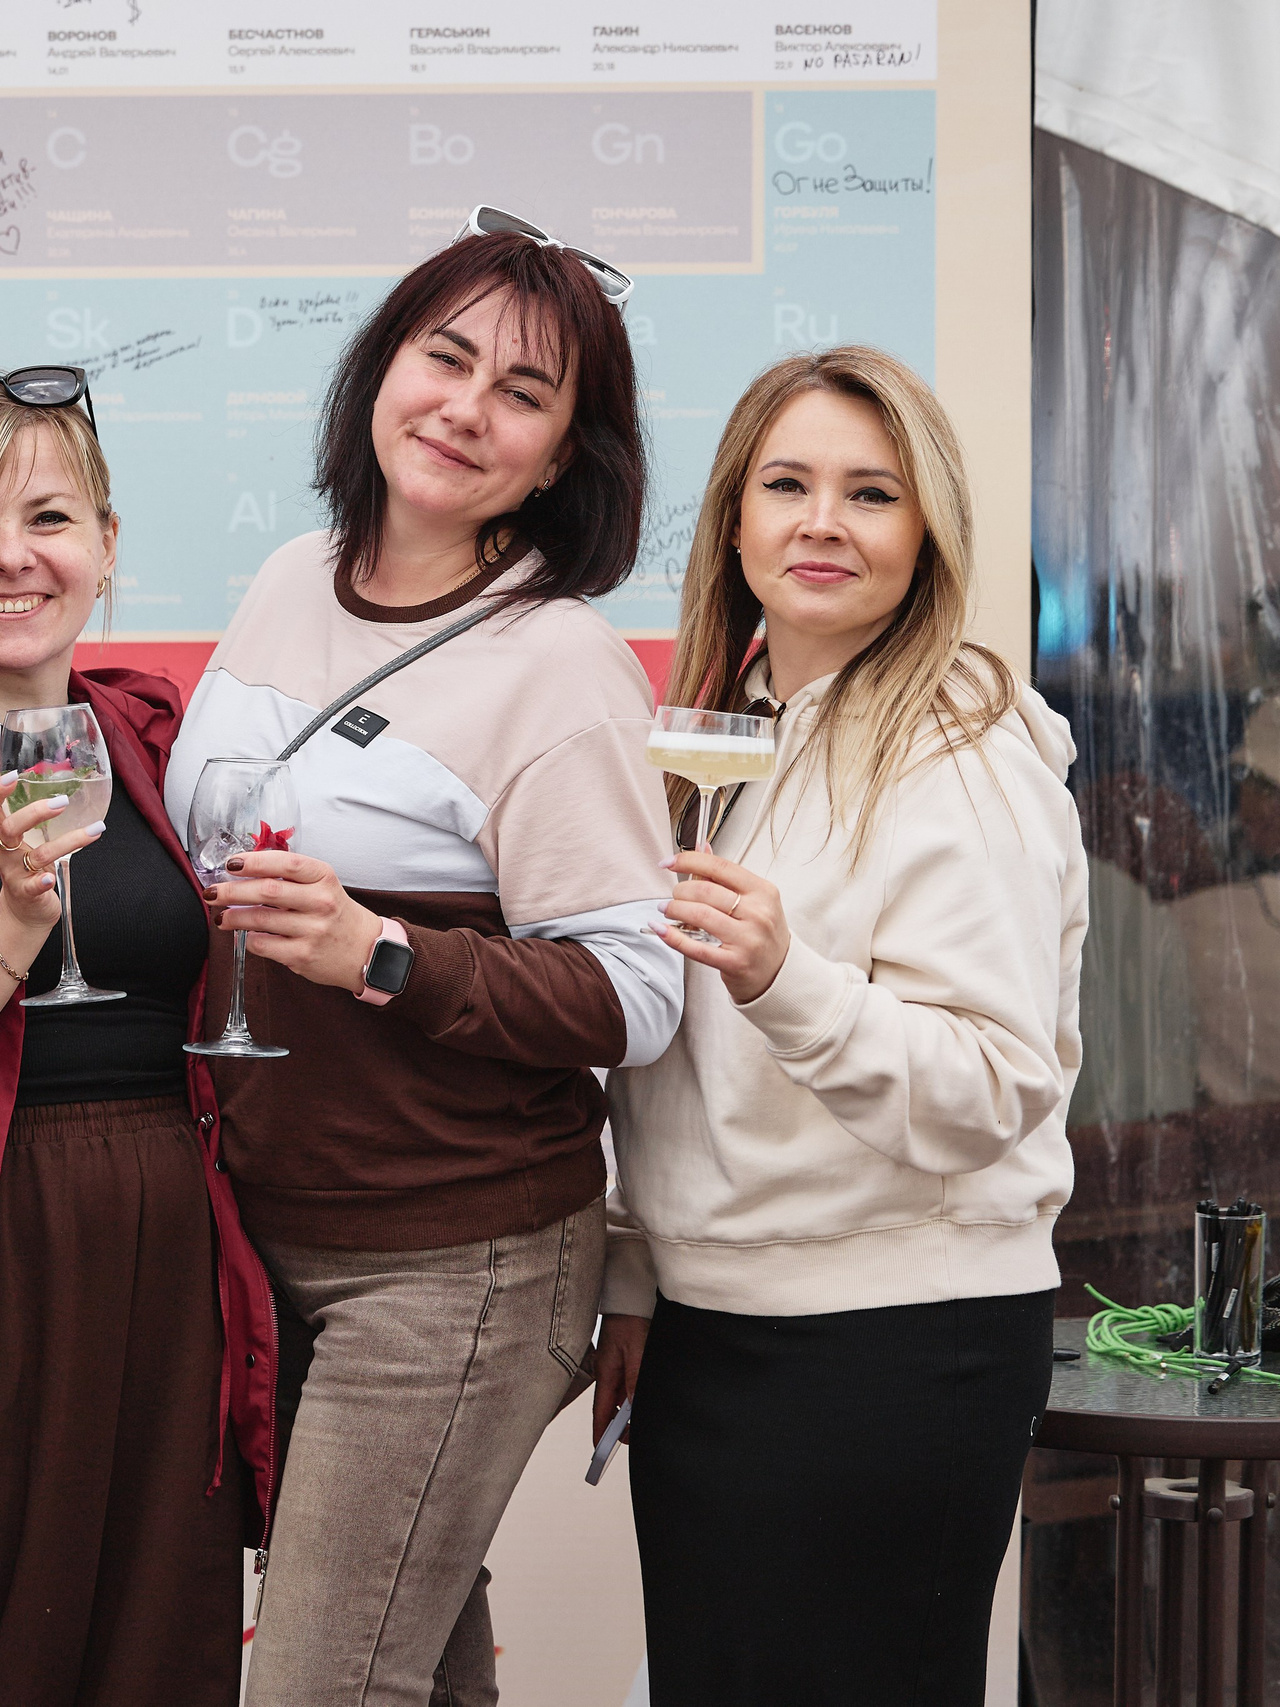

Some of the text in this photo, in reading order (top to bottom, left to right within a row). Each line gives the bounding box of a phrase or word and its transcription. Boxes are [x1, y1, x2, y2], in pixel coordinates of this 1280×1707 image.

[47, 29, 118, 42] ВОРОНОВ
[228, 28, 325, 41] БЕСЧАСТНОВ
[409, 27, 491, 40] ГЕРАСЬКИН
[592, 25, 640, 38] ГАНИН
[775, 24, 853, 37] ВАСЕНКОВ
[47, 46, 176, 60] Андрей Валерьевич
[228, 45, 355, 59] Сергей Алексеевич
[409, 43, 560, 57] Василий Владимирович
[592, 41, 739, 55] Александр Николаевич
[775, 40, 822, 54] Виктор
[803, 57, 824, 71] NO
[47, 127, 88, 170] C
[409, 123, 475, 165] Bo
[591, 122, 665, 165] Gn
[774, 120, 848, 164] Go
[227, 125, 303, 179] Cg
[46, 307, 110, 351] Sk
[774, 303, 839, 346] Ru
